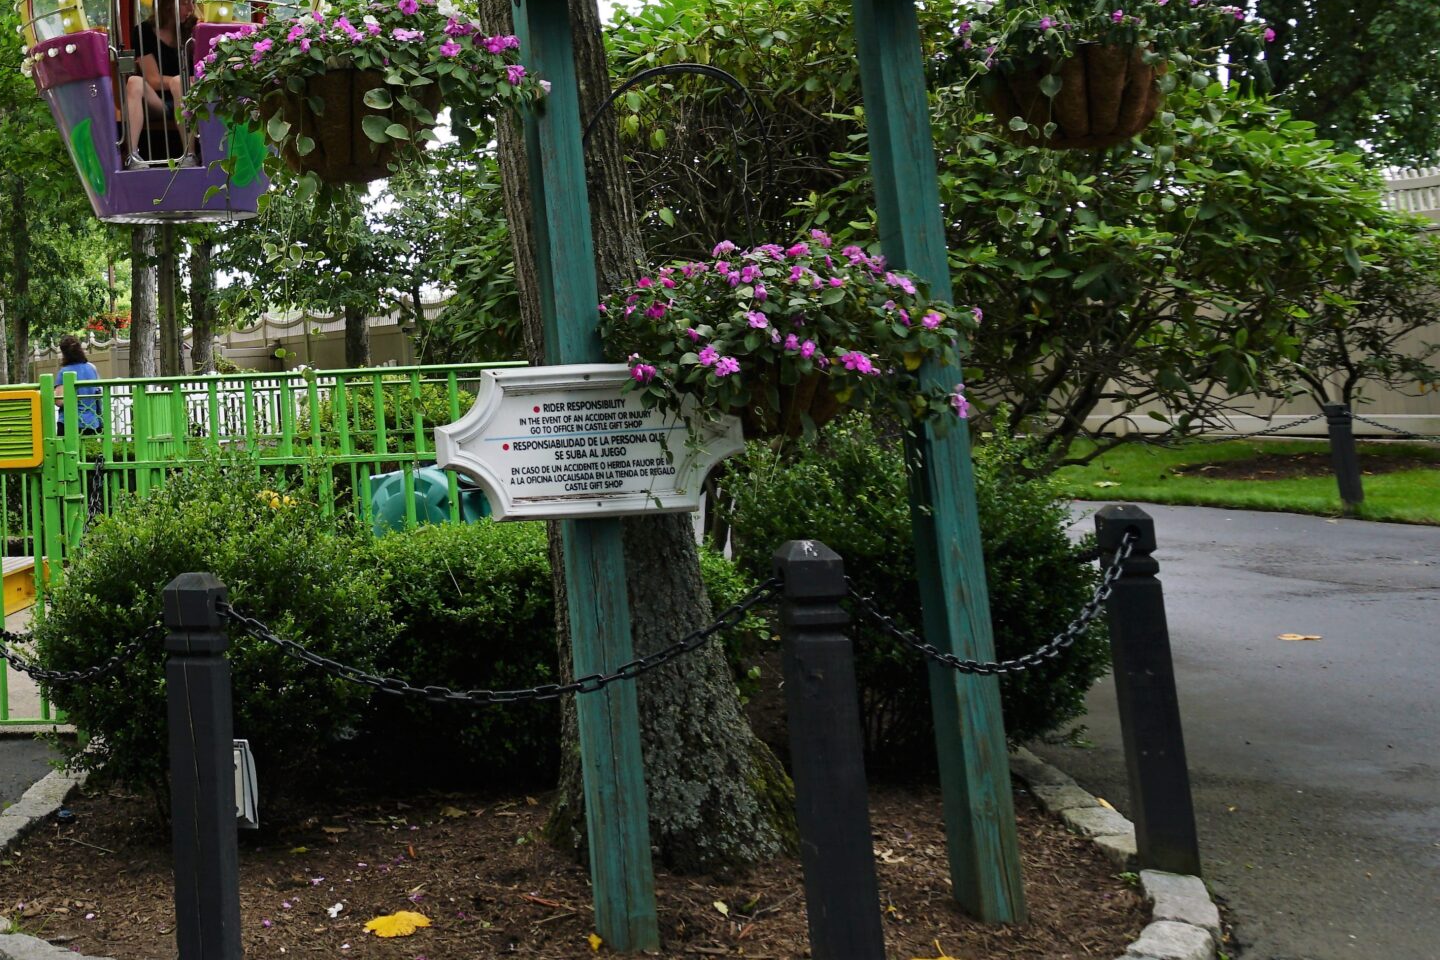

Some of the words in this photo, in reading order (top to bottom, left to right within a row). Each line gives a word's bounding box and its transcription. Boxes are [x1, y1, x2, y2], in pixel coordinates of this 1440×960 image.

[544, 403, 565, 412] RIDER
[567, 399, 625, 411] RESPONSIBILITY
[542, 416, 561, 424] EVENT
[563, 415, 572, 423] OF
[585, 413, 616, 421] ACCIDENT
[618, 412, 627, 420] OR
[629, 410, 651, 419] INJURY
[531, 427, 541, 435] GO
[543, 426, 551, 434] TO
[553, 425, 574, 433] OFFICE
[584, 422, 607, 431] CASTLE
[609, 421, 623, 430] GIFT
[625, 420, 642, 429] SHOP
[588, 437, 598, 447] DE
[600, 436, 609, 446] LA
[611, 433, 647, 445] PERSONA
[555, 451, 564, 460] SE
[566, 449, 587, 459] SUBA
[589, 449, 599, 458] AL
[601, 447, 626, 457] JUEGO
[522, 466, 540, 474] CASO
[552, 465, 562, 473] UN
[564, 462, 599, 472] ACCIDENTE
[607, 460, 631, 469] HERIDA
[517, 477, 525, 485] LA
[527, 475, 552, 484] OFICINA
[554, 473, 594, 482] LOCALISADA
[596, 472, 604, 480] EN
[606, 471, 614, 479] LA
[615, 469, 638, 477] TIENDA
[640, 468, 648, 476] DE
[650, 467, 675, 476] REGALO
[565, 483, 587, 491] CASTLE
[590, 481, 603, 489] GIFT
[605, 480, 623, 488] SHOP
